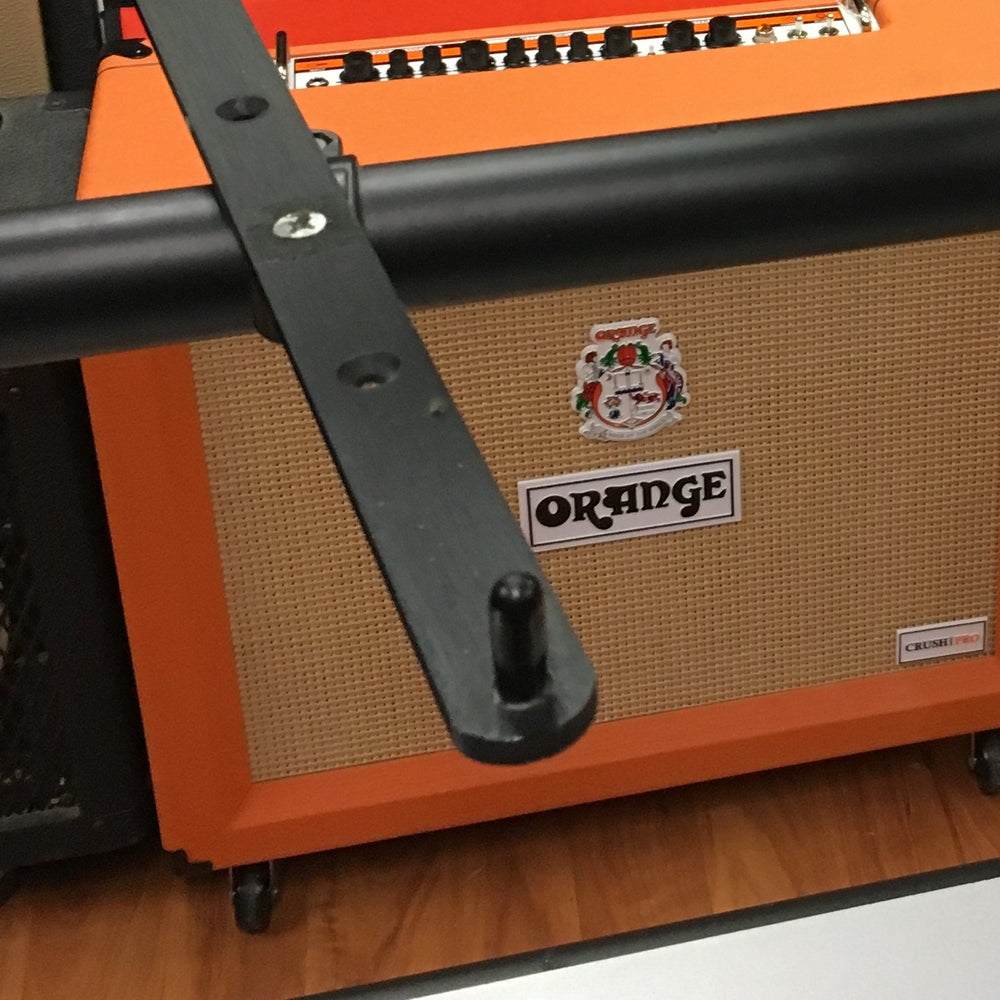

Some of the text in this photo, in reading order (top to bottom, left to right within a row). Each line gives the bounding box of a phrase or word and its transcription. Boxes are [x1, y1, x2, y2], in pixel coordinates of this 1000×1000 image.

[535, 470, 727, 530] ORANGE
[905, 632, 980, 652] CRUSH PRO
